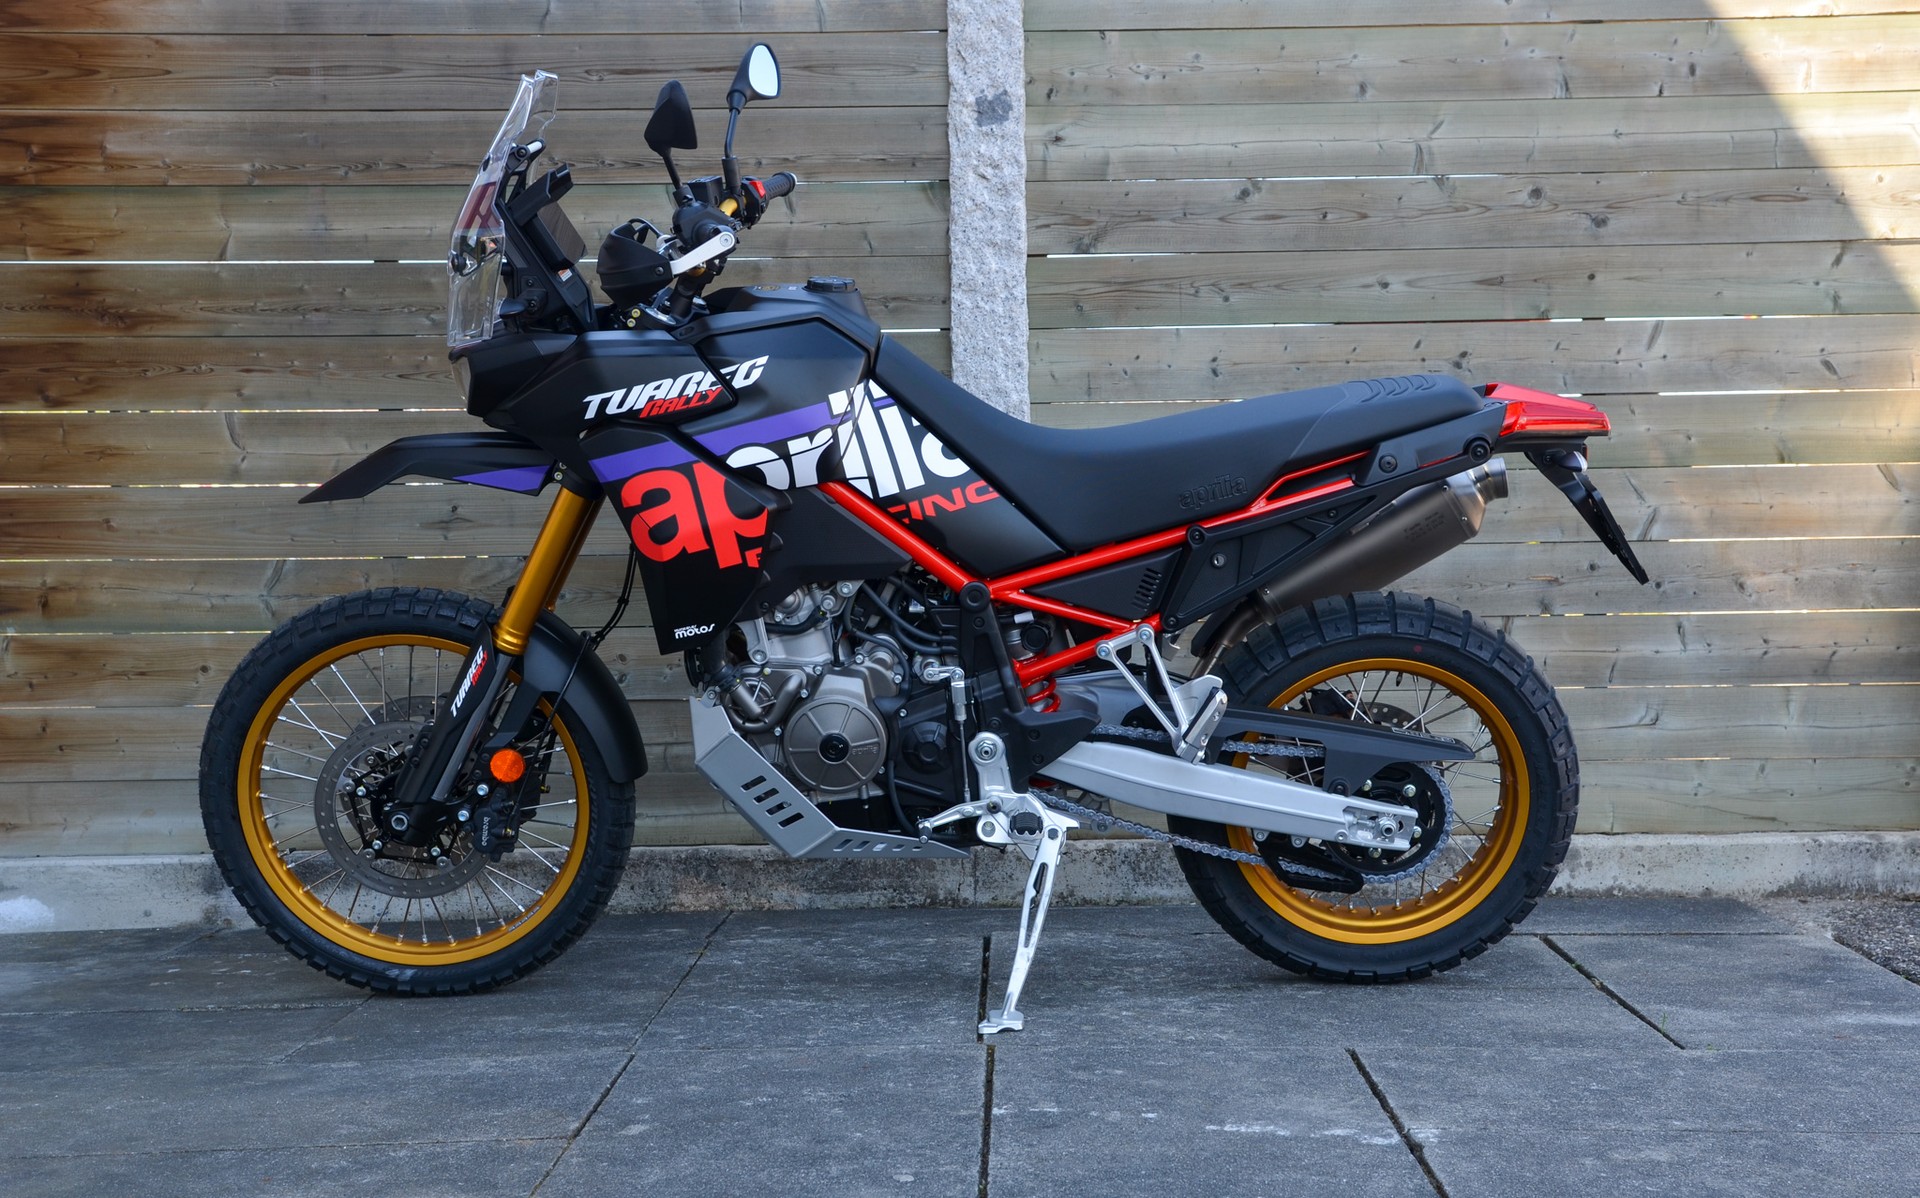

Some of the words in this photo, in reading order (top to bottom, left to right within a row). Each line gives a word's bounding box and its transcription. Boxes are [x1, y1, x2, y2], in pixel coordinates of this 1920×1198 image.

[582, 355, 770, 420] TUAREG
[639, 386, 724, 419] RALLY
[1179, 474, 1248, 510] aprilia
[674, 623, 716, 639] motos
[450, 644, 484, 718] TUAREG
[481, 816, 491, 847] brembo
